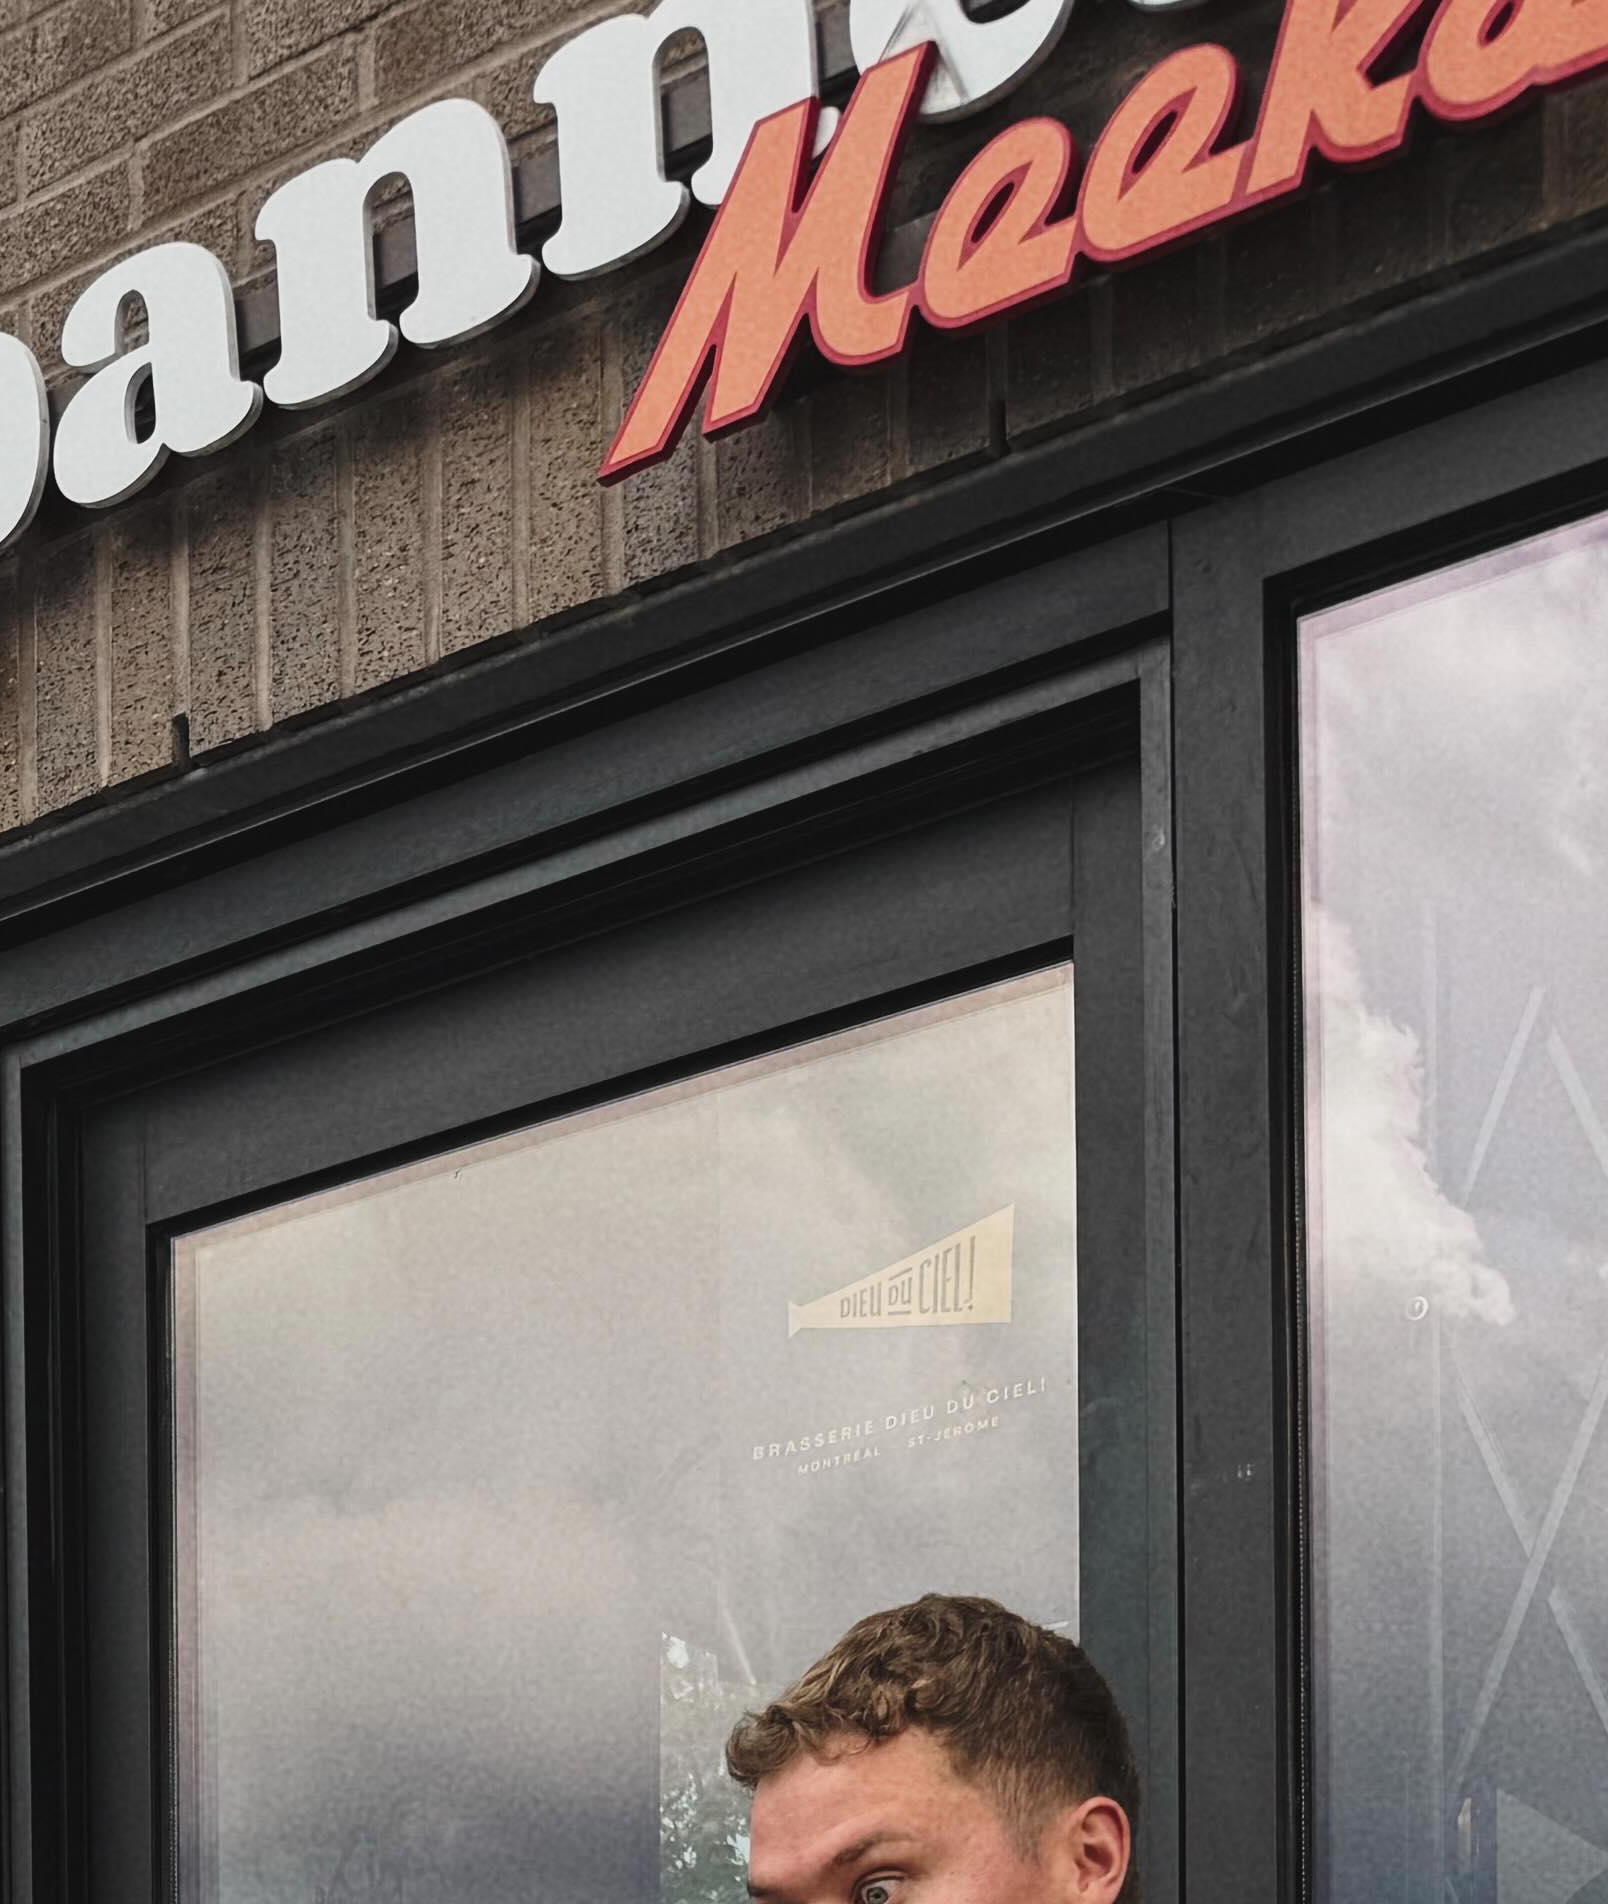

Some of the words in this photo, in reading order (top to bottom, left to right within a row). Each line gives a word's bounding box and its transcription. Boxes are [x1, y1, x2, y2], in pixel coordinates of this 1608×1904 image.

[840, 1281, 882, 1318] DIEU
[888, 1277, 912, 1306] DU
[919, 1235, 976, 1314] CIEL!
[752, 1420, 874, 1460] BRASSERIE
[885, 1404, 934, 1430] DIEU
[946, 1394, 974, 1414] DU
